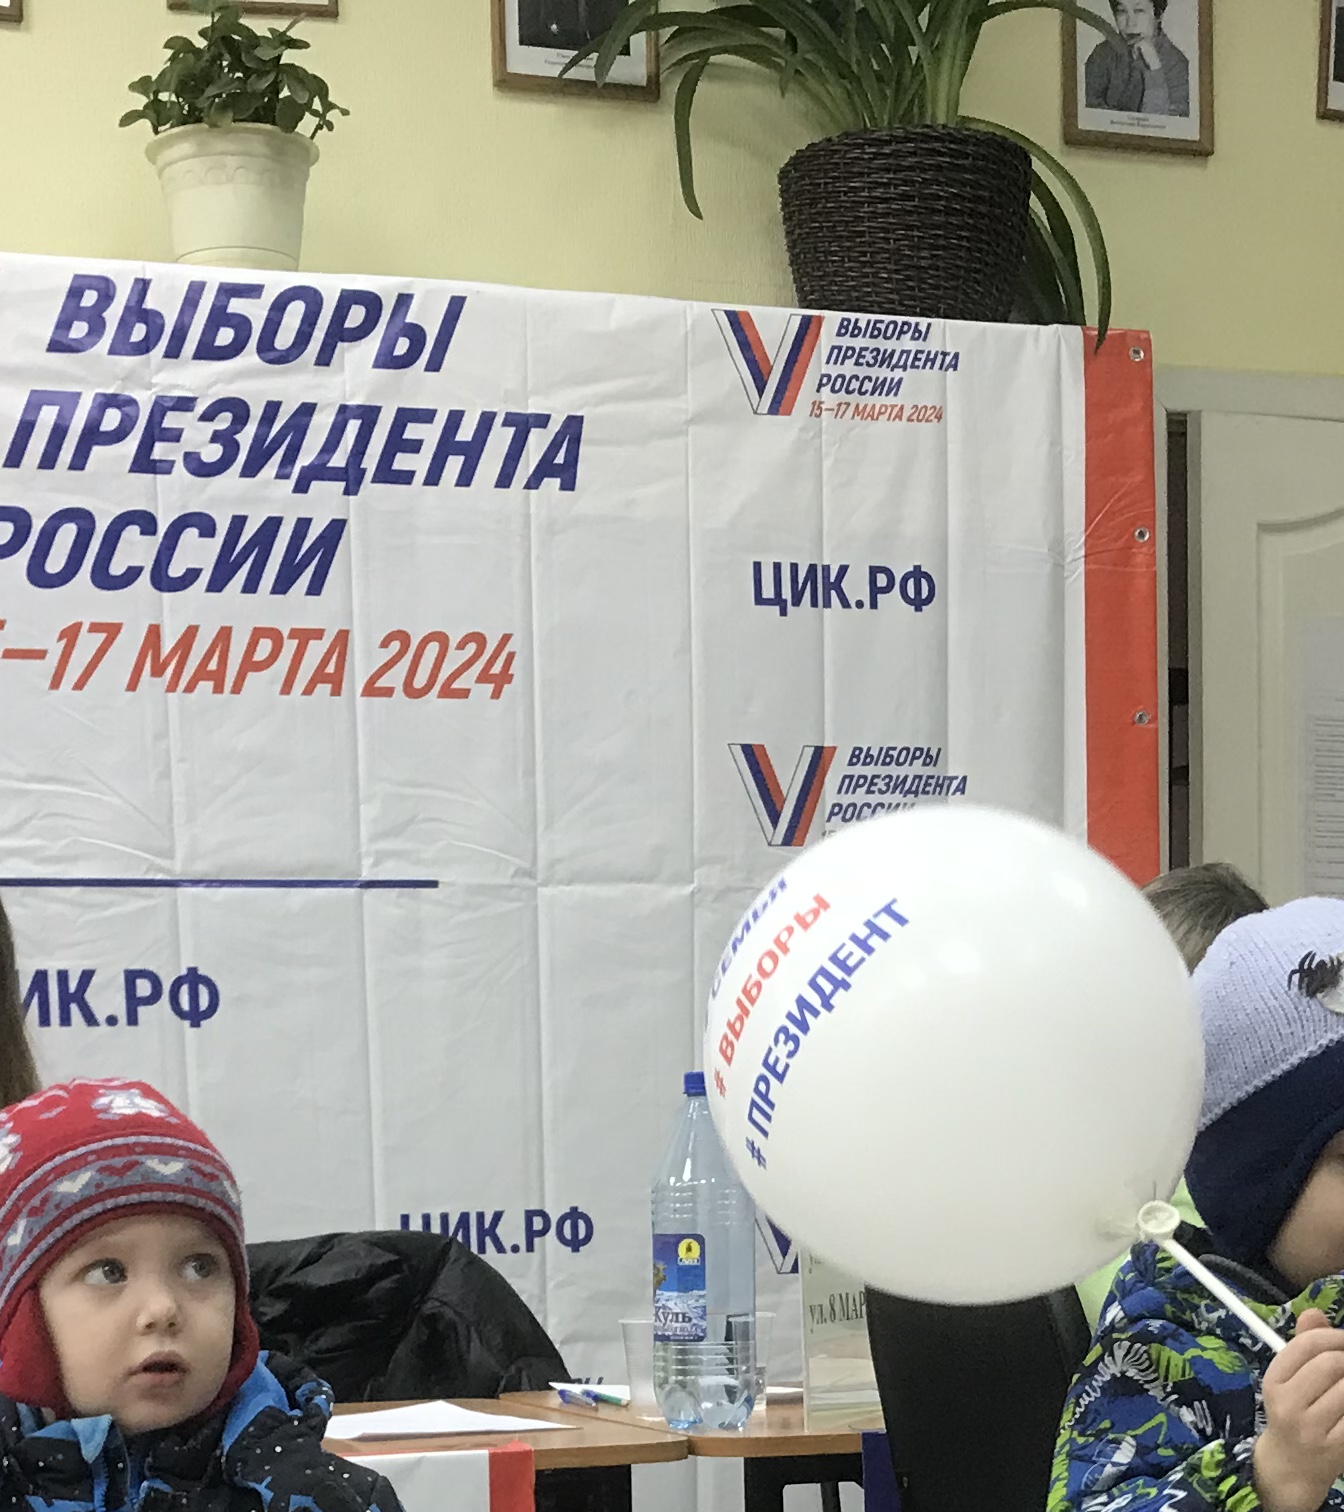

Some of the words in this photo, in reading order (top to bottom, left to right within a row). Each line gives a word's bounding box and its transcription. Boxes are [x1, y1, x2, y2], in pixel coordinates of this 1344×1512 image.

[46, 273, 468, 373] ВЫБОРЫ
[835, 316, 932, 343] ВЫБОРЫ
[824, 344, 961, 373] ПРЕЗИДЕНТА
[816, 373, 904, 398] РОССИИ
[851, 402, 905, 422] МАРТА
[906, 404, 944, 423] 2024
[2, 388, 585, 497] ПРЕЗИДЕНТА
[752, 560, 937, 618] ЦИК.РФ
[125, 622, 351, 698] МАРТА
[360, 629, 517, 701] 2024
[846, 745, 943, 768] ВЫБОРЫ
[836, 773, 969, 799] ПРЕЗИДЕНТА
[18, 965, 221, 1029] ИК.РФ
[828, 1293, 836, 1324] 8
